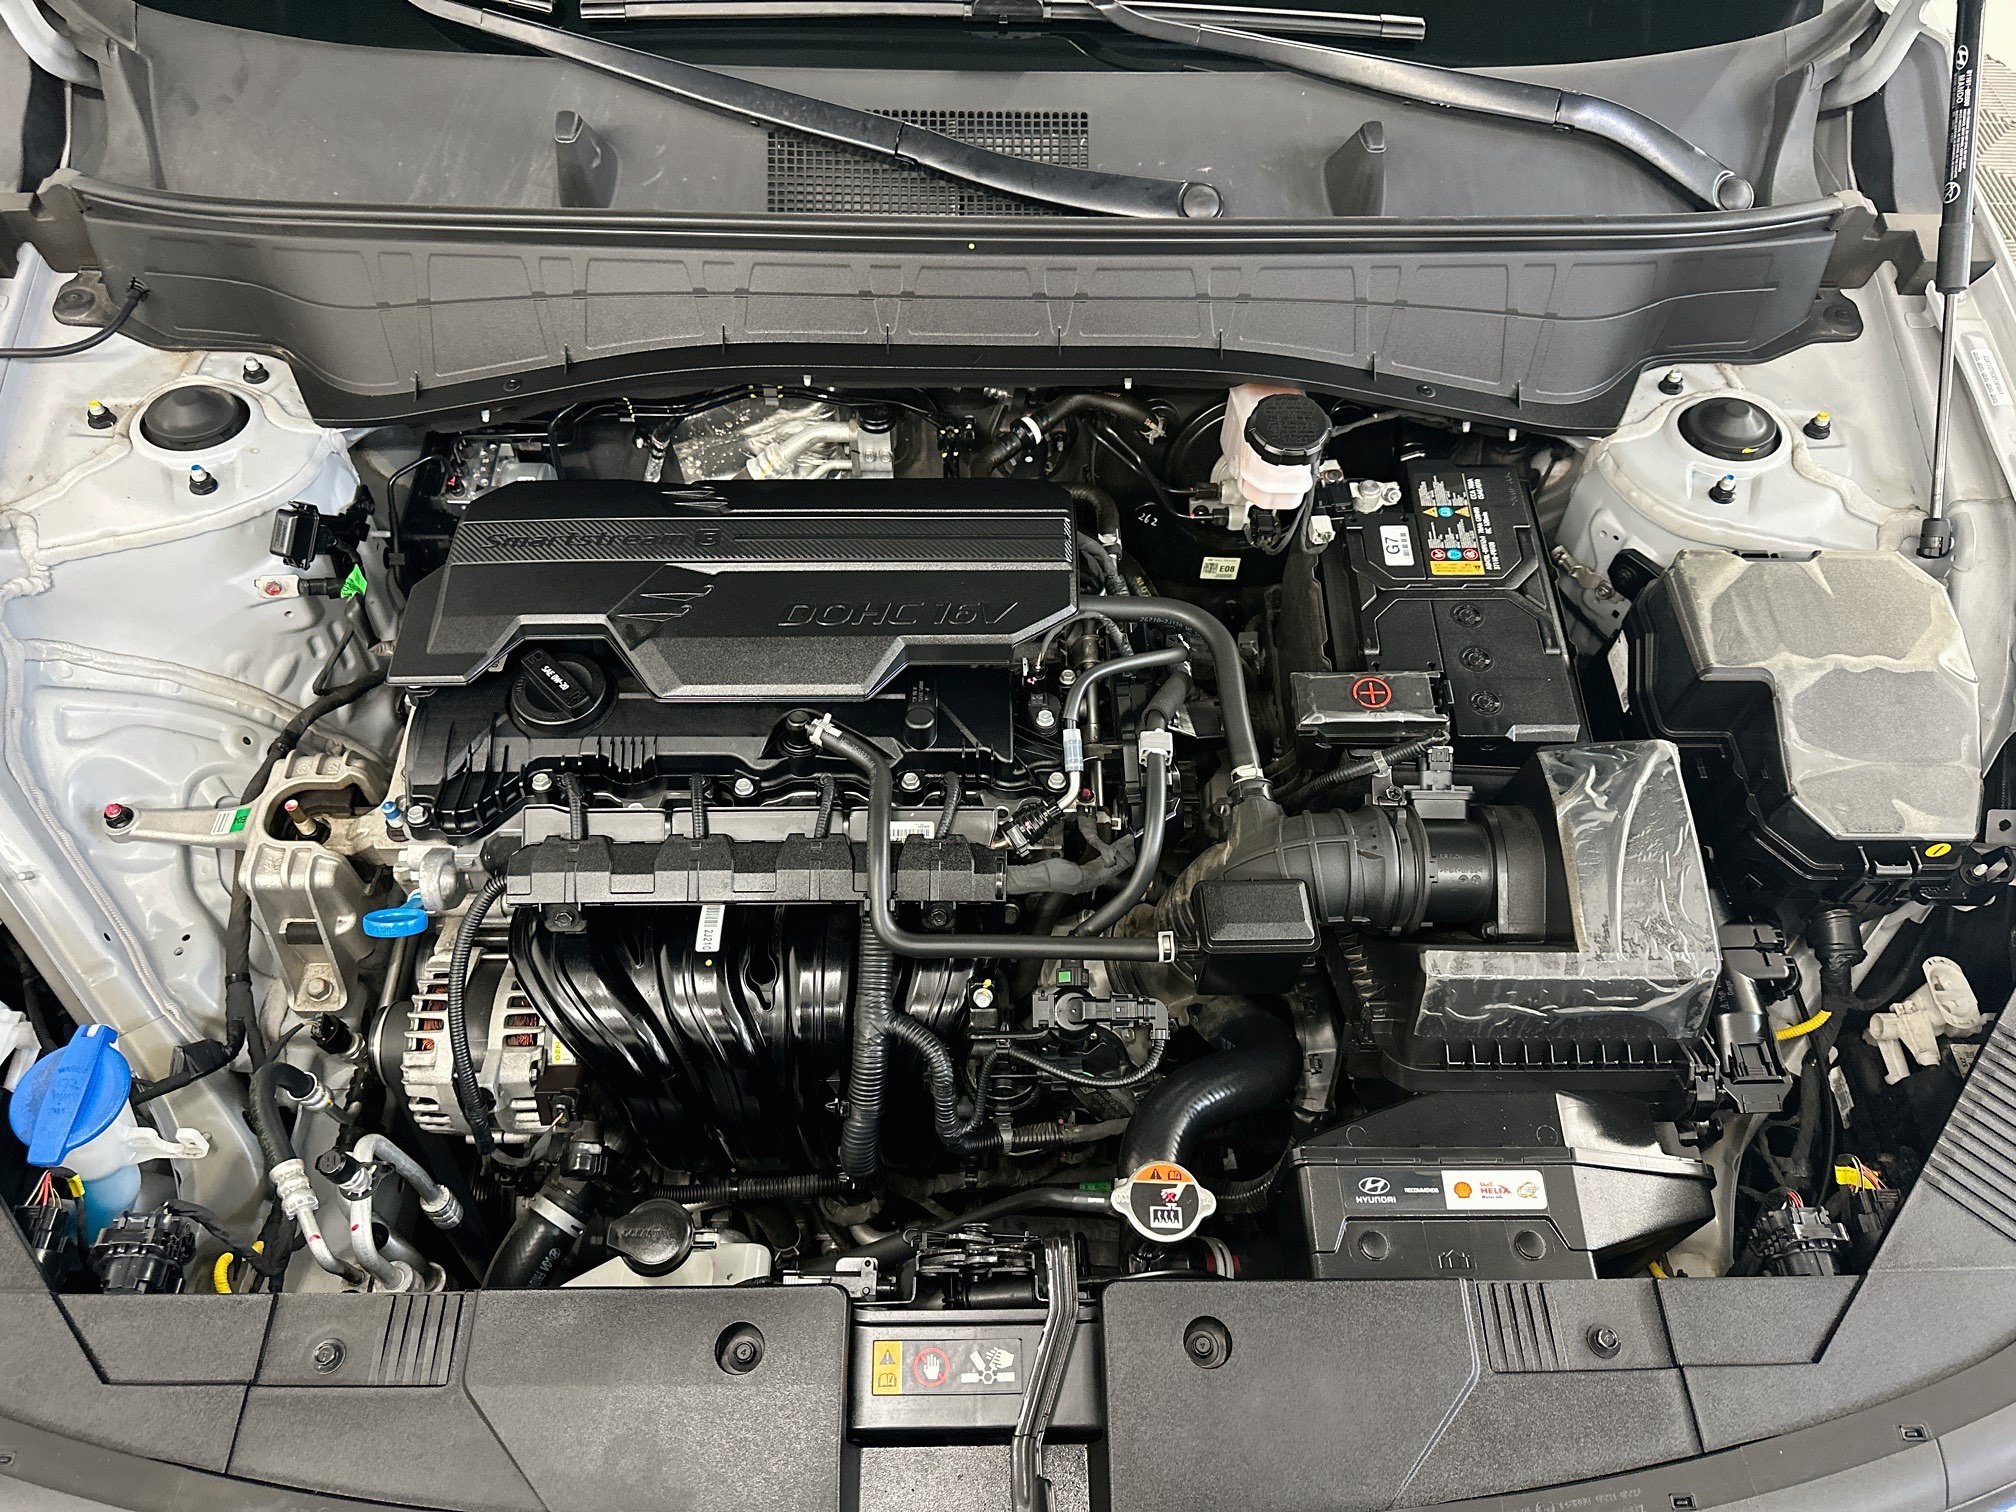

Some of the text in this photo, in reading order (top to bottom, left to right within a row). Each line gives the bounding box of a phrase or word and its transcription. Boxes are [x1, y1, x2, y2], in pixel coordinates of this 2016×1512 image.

[1956, 74, 1966, 104] MANDO
[1138, 512, 1158, 527] 262
[480, 531, 686, 548] Smartstream
[1385, 537, 1401, 554] G7
[1219, 565, 1236, 573] E08
[777, 602, 1019, 626] DOHC 16V
[541, 665, 570, 691] SAE 0W-20
[702, 929, 714, 951] 2J210
[1480, 1185, 1512, 1194] HELIX
[1356, 1195, 1397, 1204] HYUNDAI
